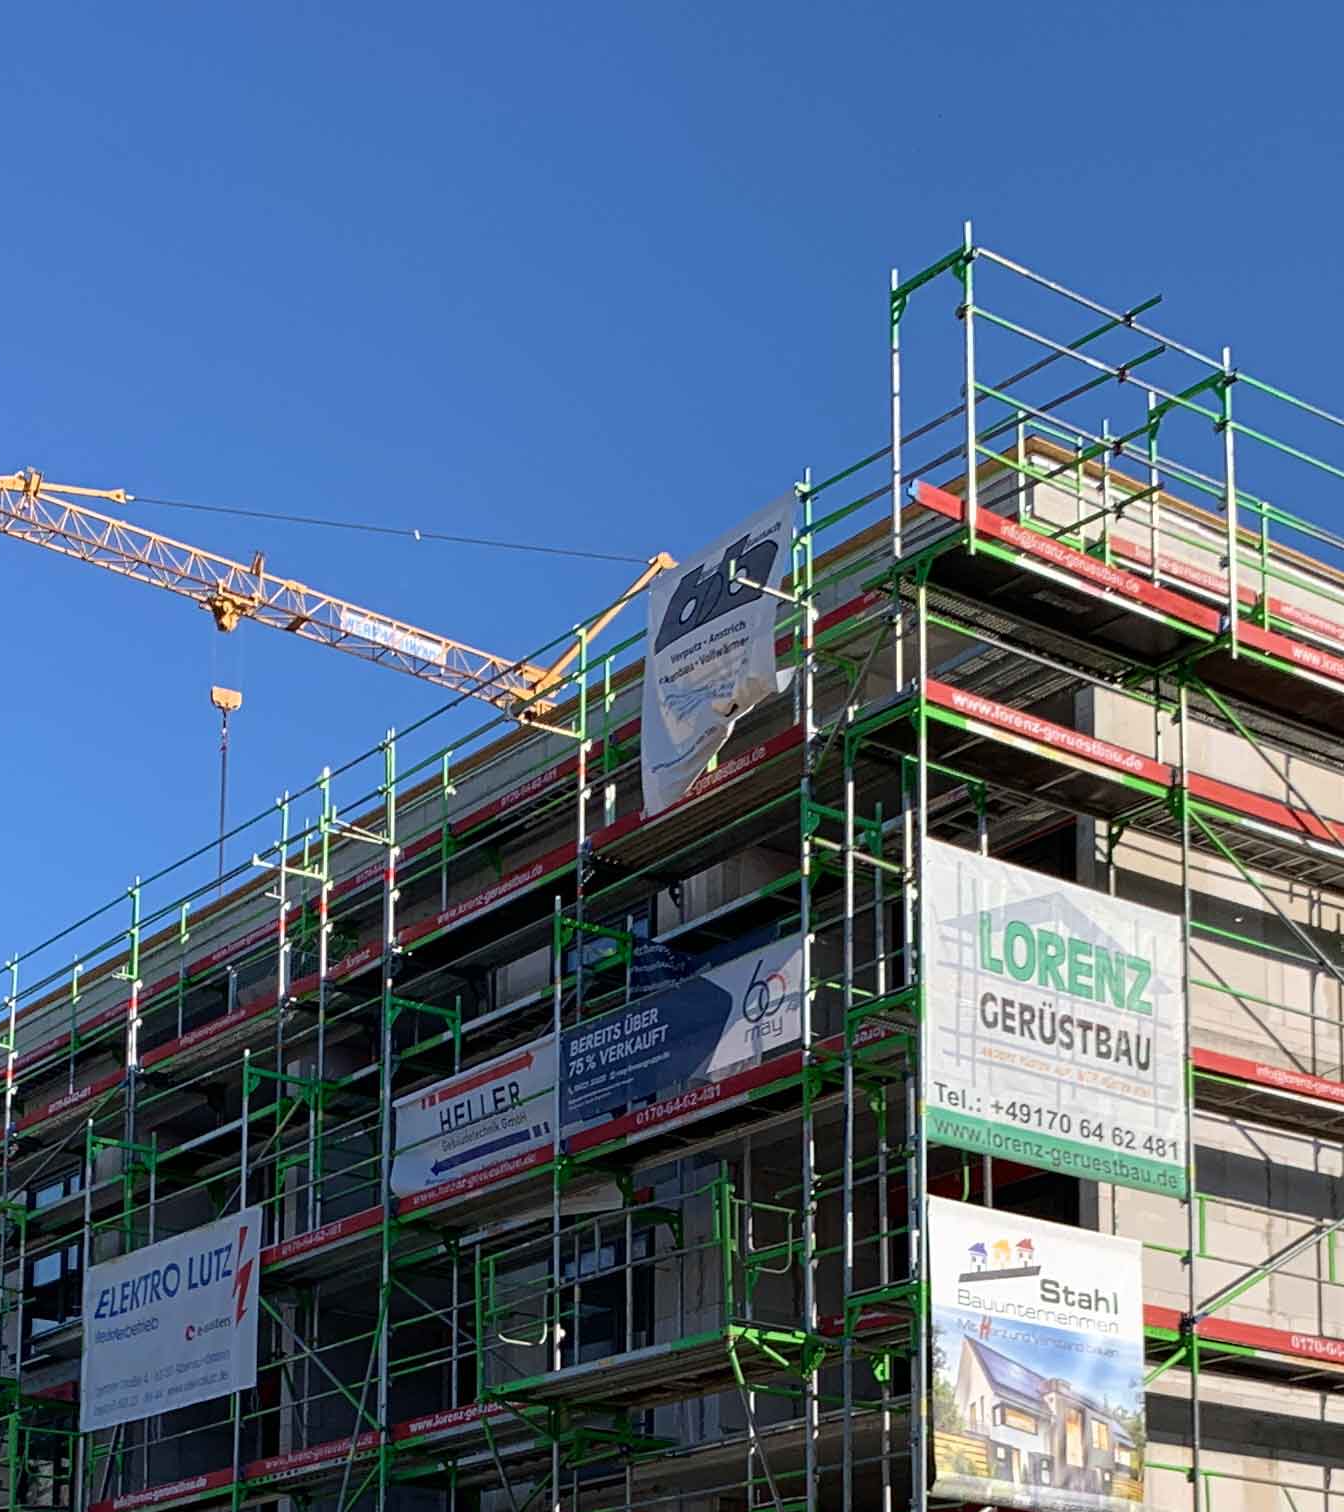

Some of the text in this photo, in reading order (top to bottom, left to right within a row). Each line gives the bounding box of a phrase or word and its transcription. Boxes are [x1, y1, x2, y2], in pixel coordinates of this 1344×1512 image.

[952, 691, 1143, 772] www.lorenz-geruestbau.de
[979, 912, 1153, 1016] LORENZ
[569, 1008, 659, 1057] BEREITS ÜBER
[599, 1024, 669, 1067] VERKAUFT
[980, 991, 1152, 1071] GERÜSTBAU
[439, 1081, 522, 1132] HELLER
[933, 1081, 1179, 1160] Tel.: +49170 64 62 481
[932, 1115, 1179, 1190] www.lorenz-geruestbau.de
[94, 1242, 233, 1320] ELEKTRO LUTZ
[1040, 1278, 1119, 1315] Stahl
